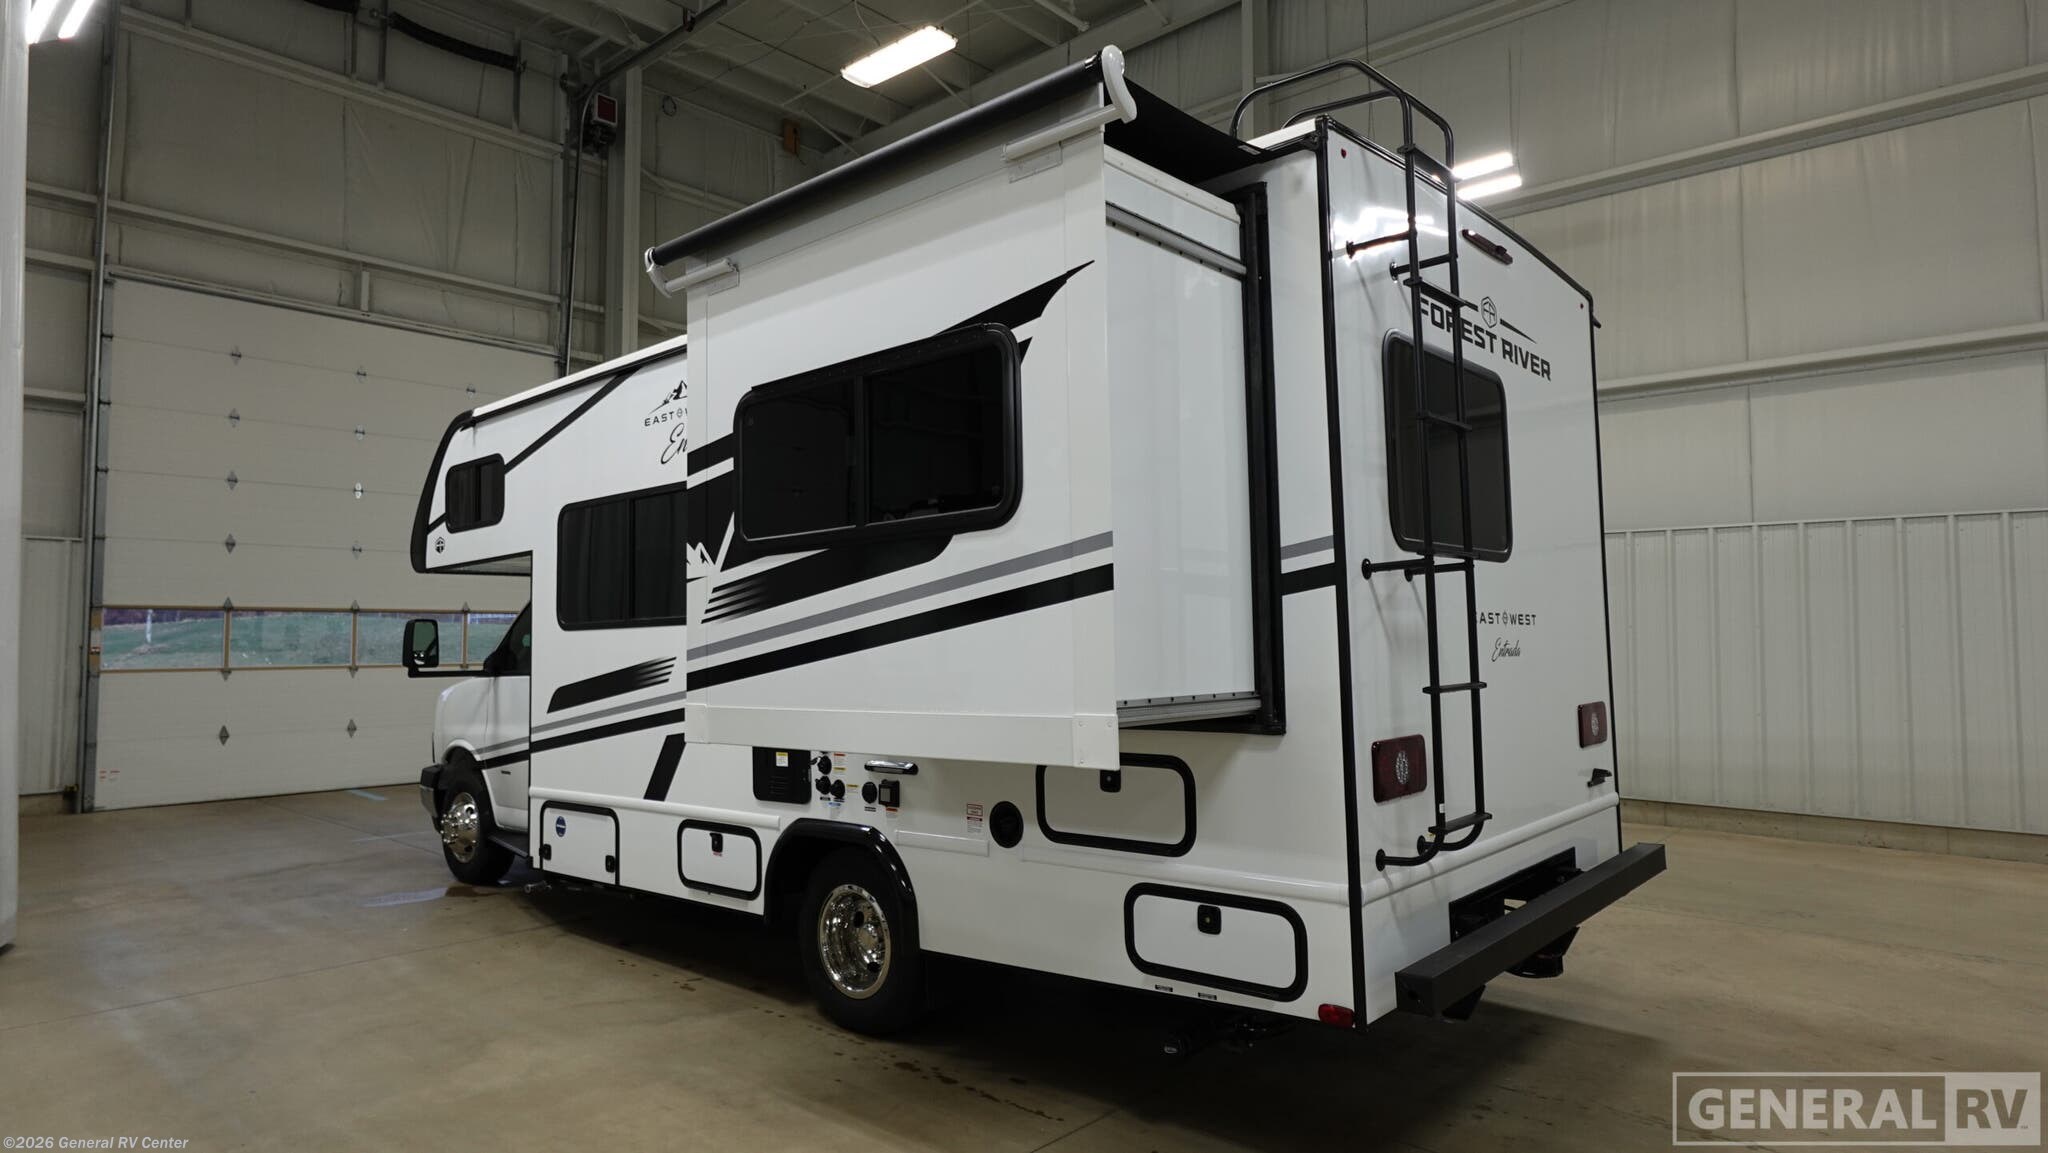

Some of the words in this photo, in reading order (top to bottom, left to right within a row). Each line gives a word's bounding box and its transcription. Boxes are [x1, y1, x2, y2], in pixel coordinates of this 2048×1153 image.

[1501, 337, 1551, 381] RIVER
[644, 411, 674, 427] EAST
[1475, 612, 1500, 625] AST
[1509, 614, 1536, 626] WEST
